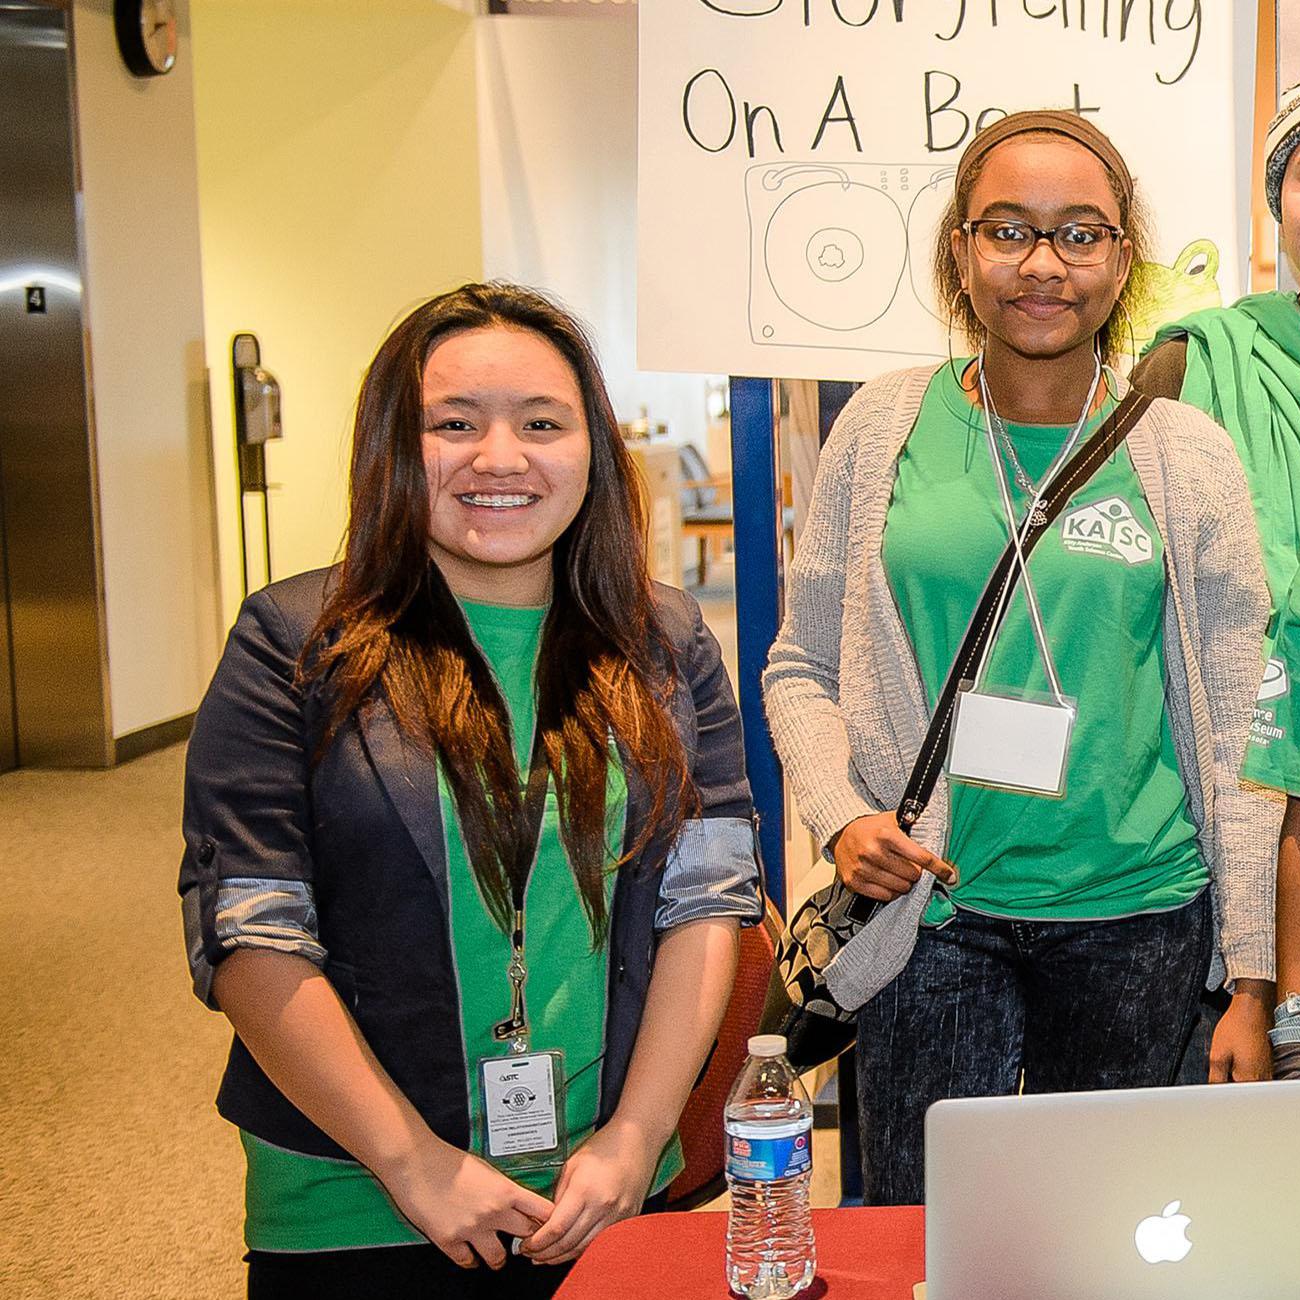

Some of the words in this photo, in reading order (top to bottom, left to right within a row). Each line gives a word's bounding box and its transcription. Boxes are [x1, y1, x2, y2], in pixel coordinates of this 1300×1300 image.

[683, 68, 785, 157] On
[811, 75, 862, 152] A
[924, 70, 1101, 152] Bet
[31, 289, 41, 307] 4
